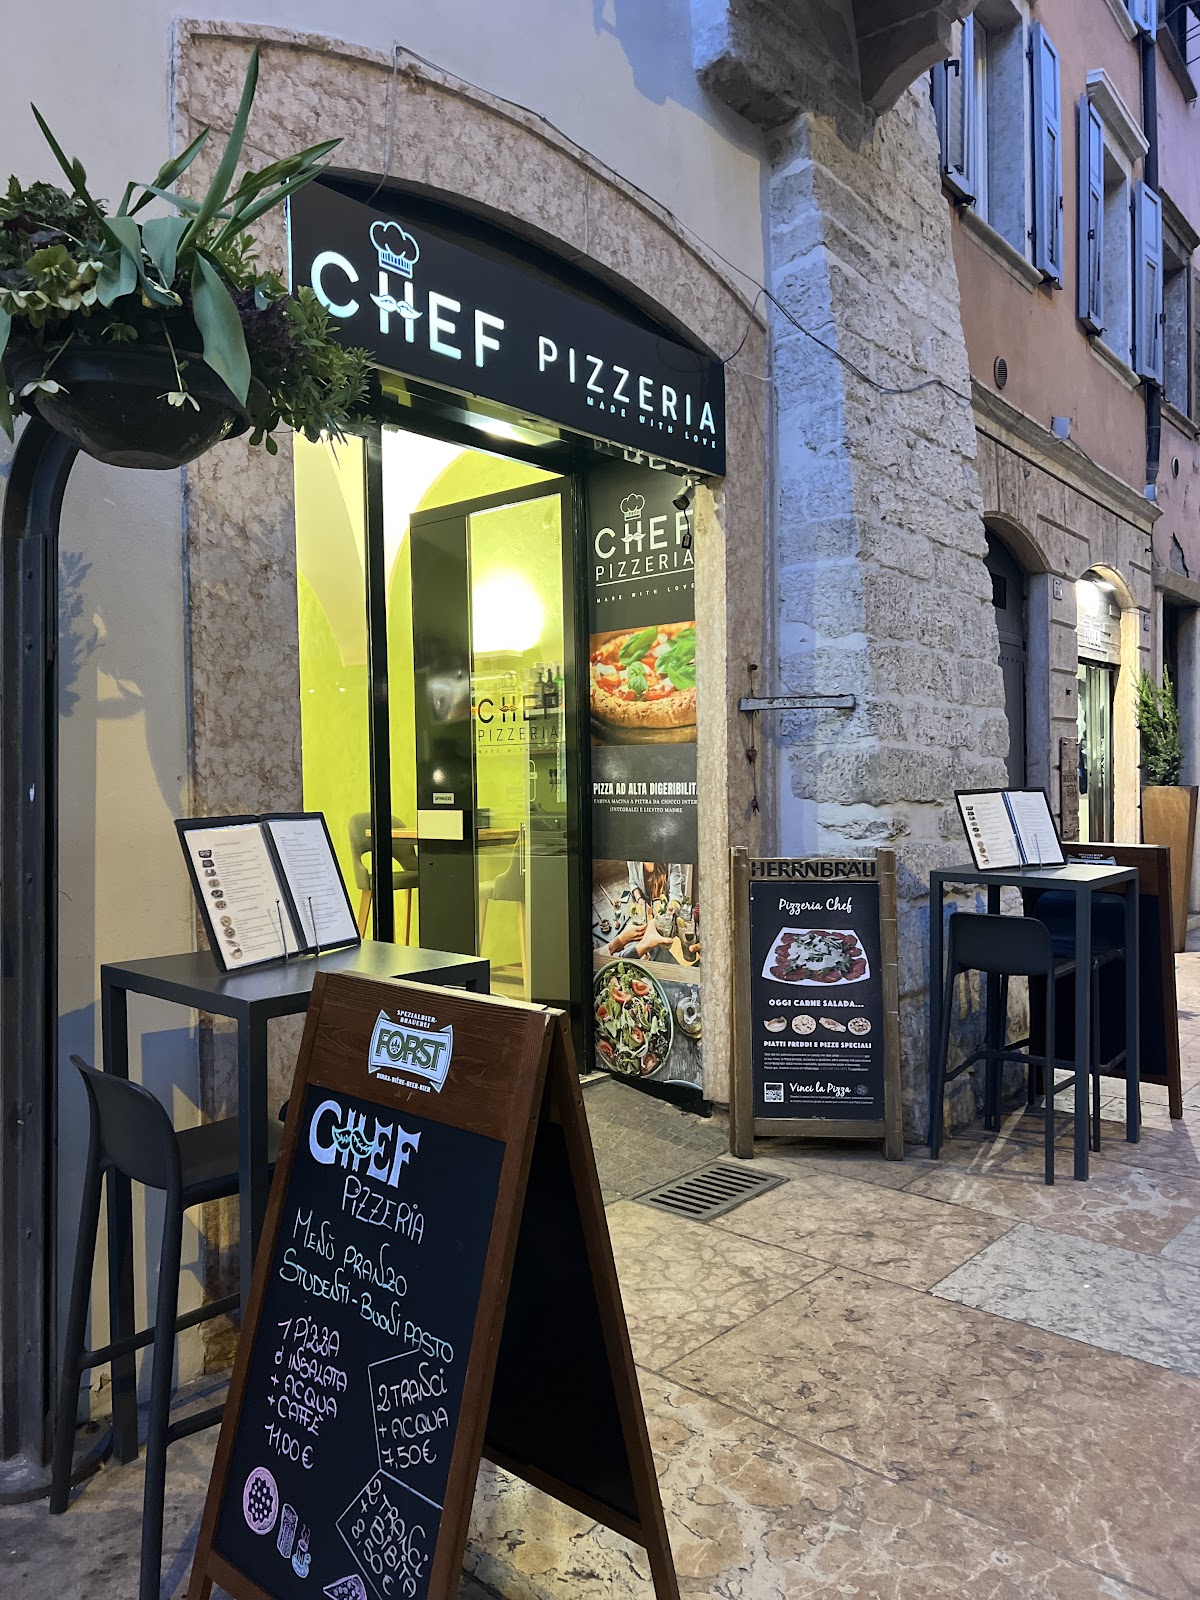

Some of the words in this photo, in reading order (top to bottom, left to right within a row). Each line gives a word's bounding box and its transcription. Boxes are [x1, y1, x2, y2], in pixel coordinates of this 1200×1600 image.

[310, 251, 505, 368] CHEF
[538, 335, 716, 435] PIZZERIA
[587, 396, 626, 418] MADE
[639, 415, 673, 434] WITH
[685, 431, 716, 449] LOVE
[594, 509, 694, 559] CHEF
[595, 549, 694, 582] PIZZERIA
[596, 594, 623, 603] MADE
[631, 589, 658, 598] WITH
[477, 693, 560, 724] CHEF
[478, 726, 559, 742] PIZZERIA
[593, 782, 614, 795] PIZZA
[615, 782, 626, 795] AD
[628, 782, 647, 795] ALTA
[649, 782, 698, 795] DIGERIBILIT
[750, 861, 876, 879] HERRNBRÄU
[778, 897, 823, 915] Pizzeria
[825, 896, 853, 914] Chef
[768, 999, 791, 1007] OGGI
[793, 999, 821, 1007] CARNE
[400, 1017, 431, 1029] BRAUEREI
[375, 1027, 447, 1072] FORST
[787, 1040, 813, 1048] FREDDI
[840, 1041, 872, 1049] SPECIALI
[789, 1082, 814, 1093] Vinci
[815, 1081, 826, 1093] la
[827, 1082, 852, 1097] Pizza
[308, 1100, 422, 1189] CHEF
[284, 1374, 338, 1419] ACQUA
[391, 1407, 449, 1440] ACQUA
